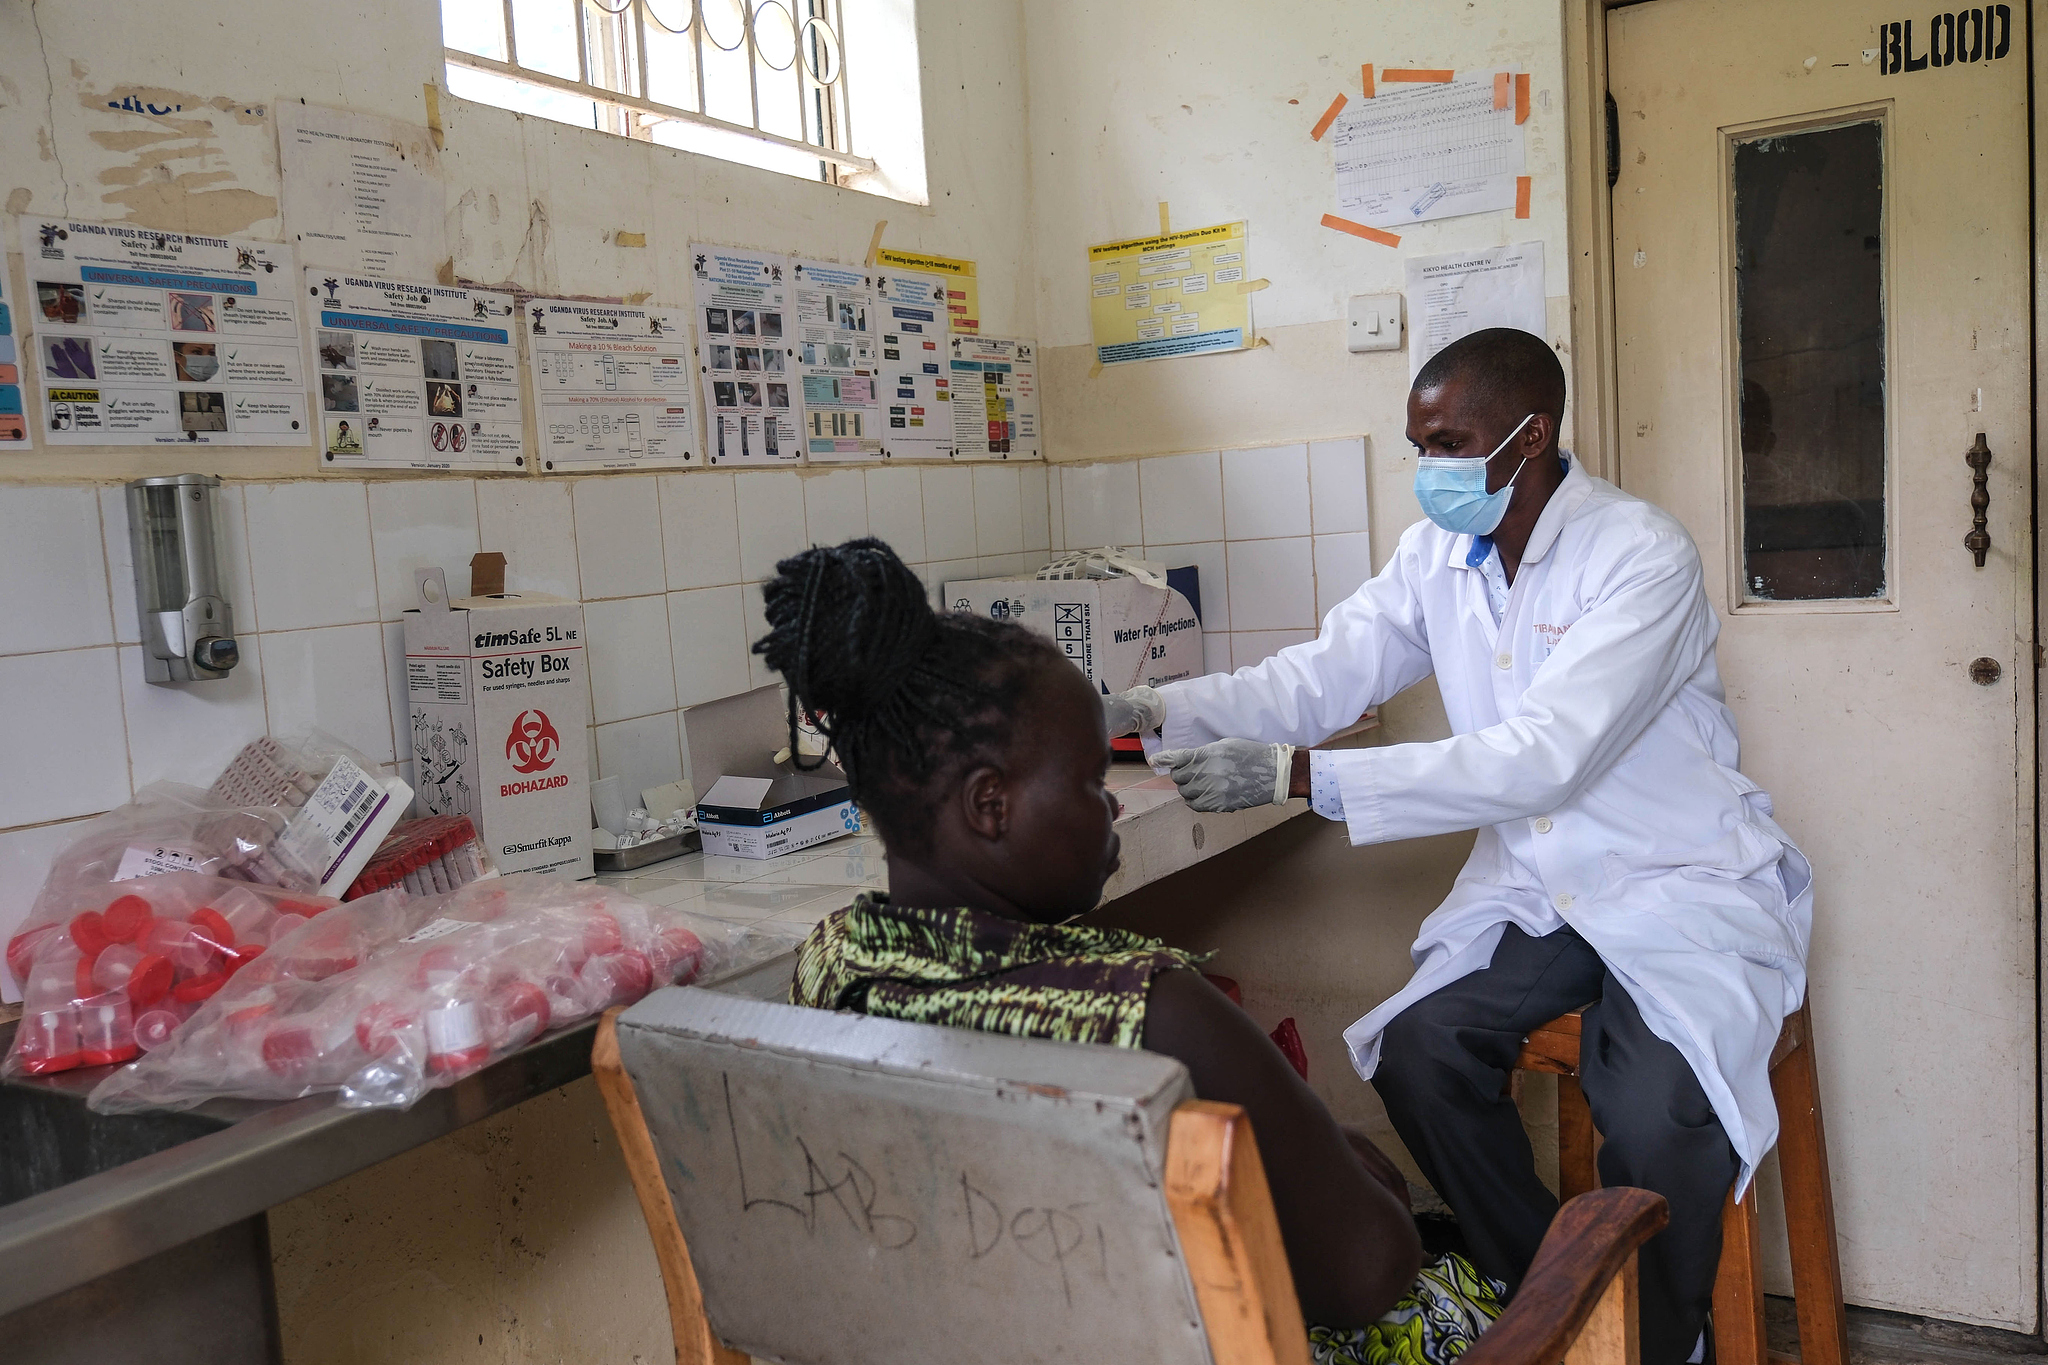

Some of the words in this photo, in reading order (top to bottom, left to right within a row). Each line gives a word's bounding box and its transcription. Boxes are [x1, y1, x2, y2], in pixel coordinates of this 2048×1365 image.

[1881, 4, 2010, 76] BLOOD
[346, 136, 372, 144] LABORATORY
[68, 223, 107, 236] UGANDA
[108, 227, 136, 238] VIRUS
[138, 230, 183, 243] RESEARCH
[185, 235, 229, 248] INSTITUTE
[1121, 242, 1144, 250] algorithm
[1169, 232, 1199, 241] HIV-Syphilis
[121, 239, 147, 251] Safety
[167, 243, 182, 253] Aid
[893, 256, 906, 264] testing
[907, 258, 924, 266] algorithm
[953, 264, 961, 272] age)
[1441, 263, 1462, 271] HEALTH
[1463, 260, 1484, 268] CENTRE
[88, 272, 146, 285] UNIVERSAL
[148, 276, 184, 288] SAFETY
[187, 280, 252, 294] PRECAUTIONS
[344, 277, 373, 289] UGANDA
[374, 280, 396, 291] VIRUS
[397, 284, 432, 296] RESEARCH
[434, 288, 467, 300] INSTITUTE
[384, 292, 404, 302] Safety
[406, 293, 418, 302] Job
[550, 306, 572, 314] UGANDA
[590, 309, 618, 317] RESEARCH
[619, 310, 645, 318] INSTITUTE
[580, 316, 596, 324] Safety
[329, 316, 391, 331] UNIVERSAL
[394, 324, 431, 335] SAFETY
[434, 327, 503, 342] PRECAUTIONS
[569, 342, 592, 351] Making
[634, 344, 657, 352] Solution
[60, 391, 99, 400] CAUTION
[76, 405, 94, 413] Safety
[1064, 608, 1071, 618] 7
[1064, 626, 1072, 637] 6
[1114, 628, 1141, 643] Water
[1143, 625, 1157, 638] For
[1159, 618, 1196, 637] Injections
[475, 628, 541, 648] timSafe
[546, 627, 562, 641] 5L
[566, 630, 577, 640] NE
[1066, 644, 1073, 654] 5
[1151, 645, 1166, 660] B.P.
[482, 658, 535, 679] Safety
[541, 655, 570, 673] Box
[506, 682, 527, 690] syringes,
[500, 775, 568, 797] BIOHAZARD
[774, 809, 791, 819] Abbott
[766, 831, 780, 839] Malaria
[517, 839, 547, 853] Smurfit
[548, 836, 572, 847] Kappa
[144, 858, 164, 866] STOOL
[722, 1071, 918, 1250] LAB
